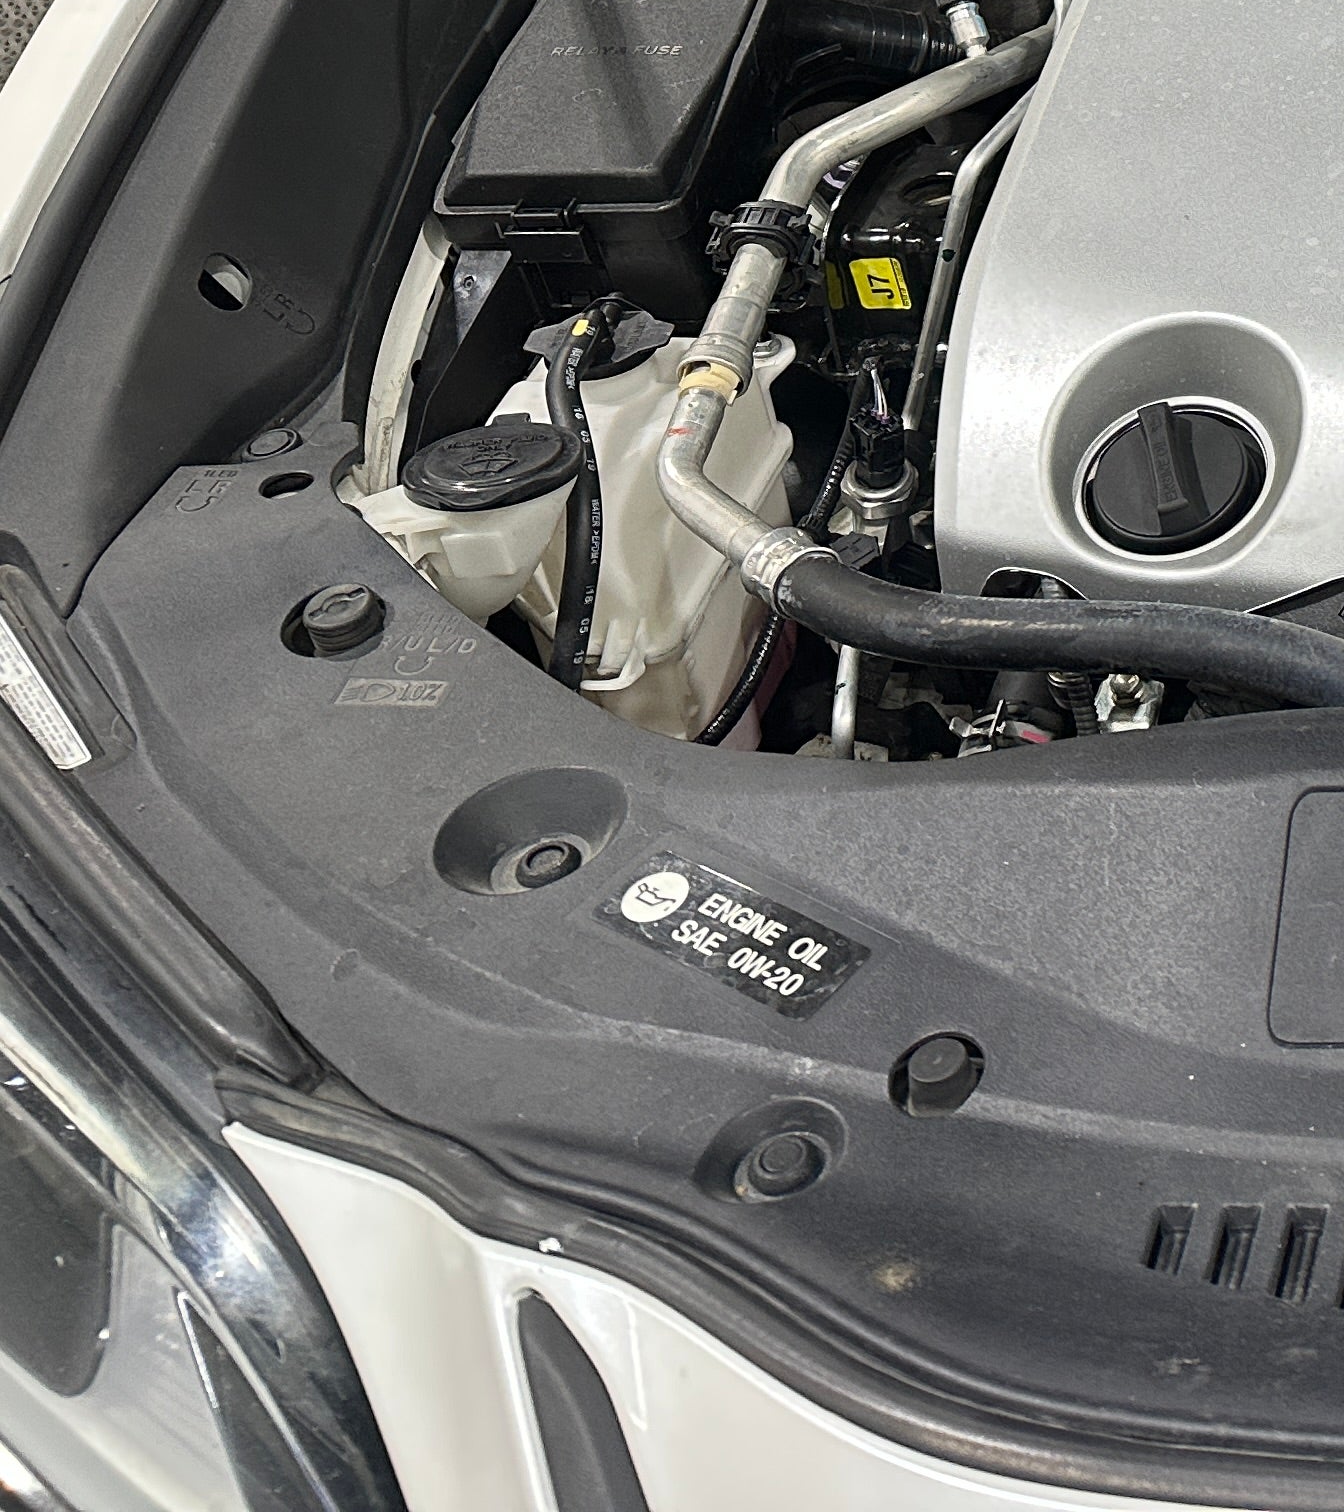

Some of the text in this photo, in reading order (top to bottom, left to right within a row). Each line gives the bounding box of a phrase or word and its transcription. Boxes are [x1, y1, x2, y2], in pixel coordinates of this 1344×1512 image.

[632, 45, 683, 56] FUSE
[867, 274, 894, 299] J7
[591, 499, 600, 527] WATER
[697, 893, 829, 972] ENGINE OIL
[671, 919, 805, 998] SAE 0W-20
